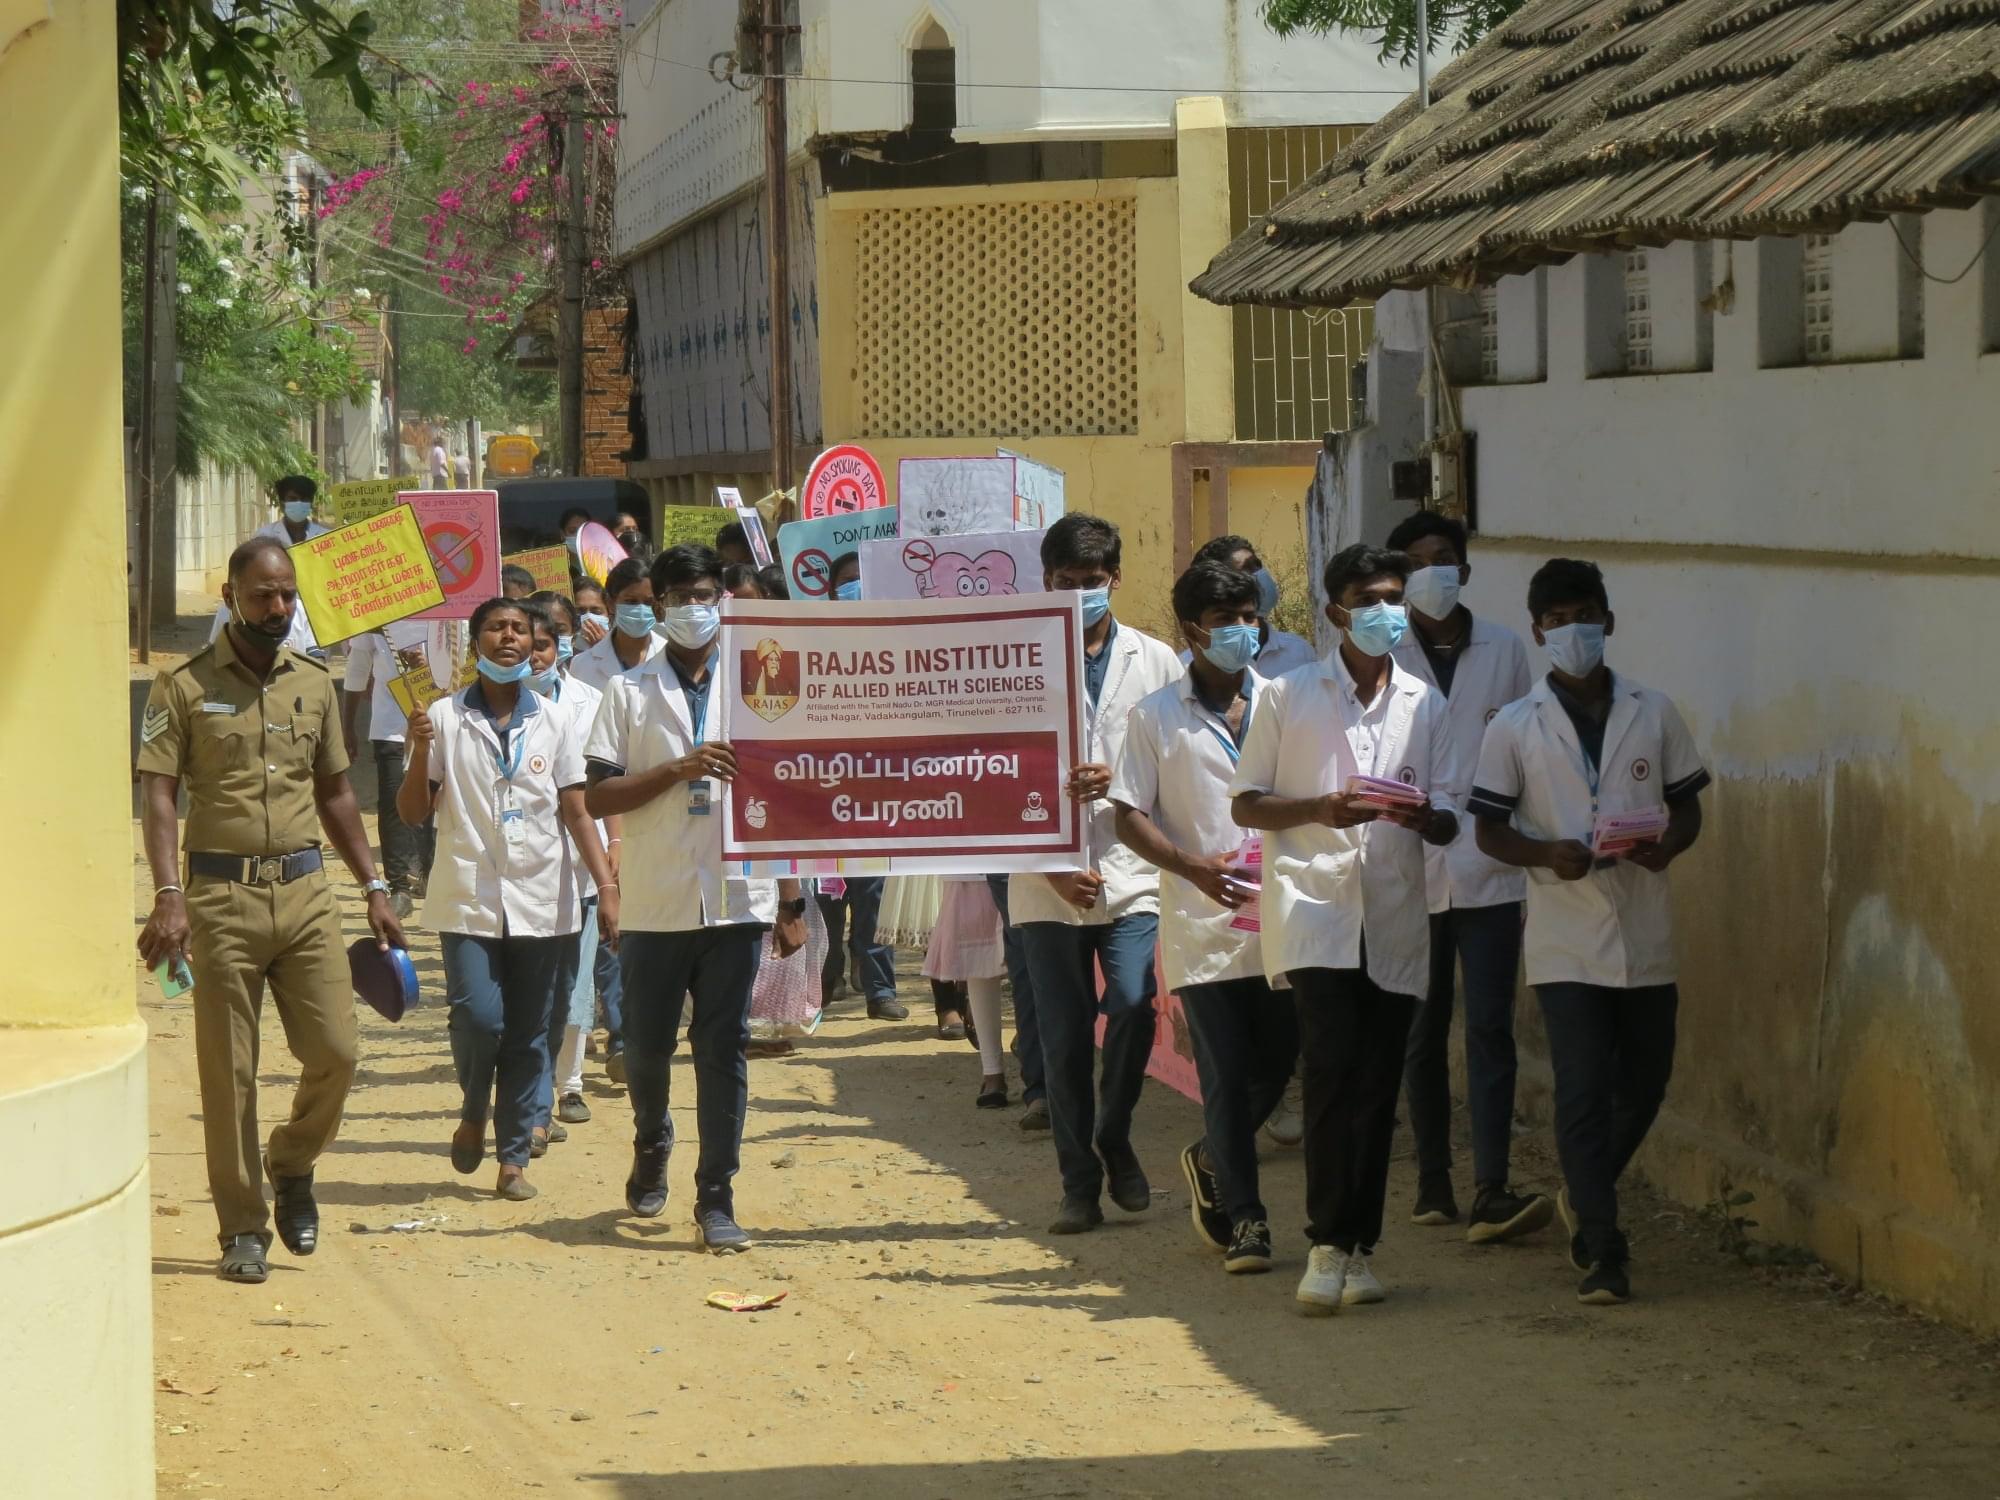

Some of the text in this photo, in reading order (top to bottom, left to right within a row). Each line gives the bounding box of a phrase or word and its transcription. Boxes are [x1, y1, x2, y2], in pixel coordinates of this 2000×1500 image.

[819, 459, 876, 498] NO SMOKING DAY
[833, 526, 870, 544] DON'T
[806, 643, 1043, 677] RAJAS INSTITUTE
[806, 675, 1045, 700] OF ALLIED HEALTH SCIENCES
[753, 698, 789, 711] RAJAS
[807, 713, 828, 723] Raja
[831, 713, 862, 723] Nagar,
[864, 710, 944, 720] Vadakkangulam,
[946, 707, 996, 717] Tirunelveli
[1005, 706, 1022, 714] 627
[1026, 705, 1046, 713] 116.
[871, 702, 890, 710] Tamil
[914, 700, 923, 708] Dr.
[946, 698, 974, 706] Medical
[774, 749, 1020, 789] விழிப்புணர்வு
[832, 790, 964, 828] பேரணி
